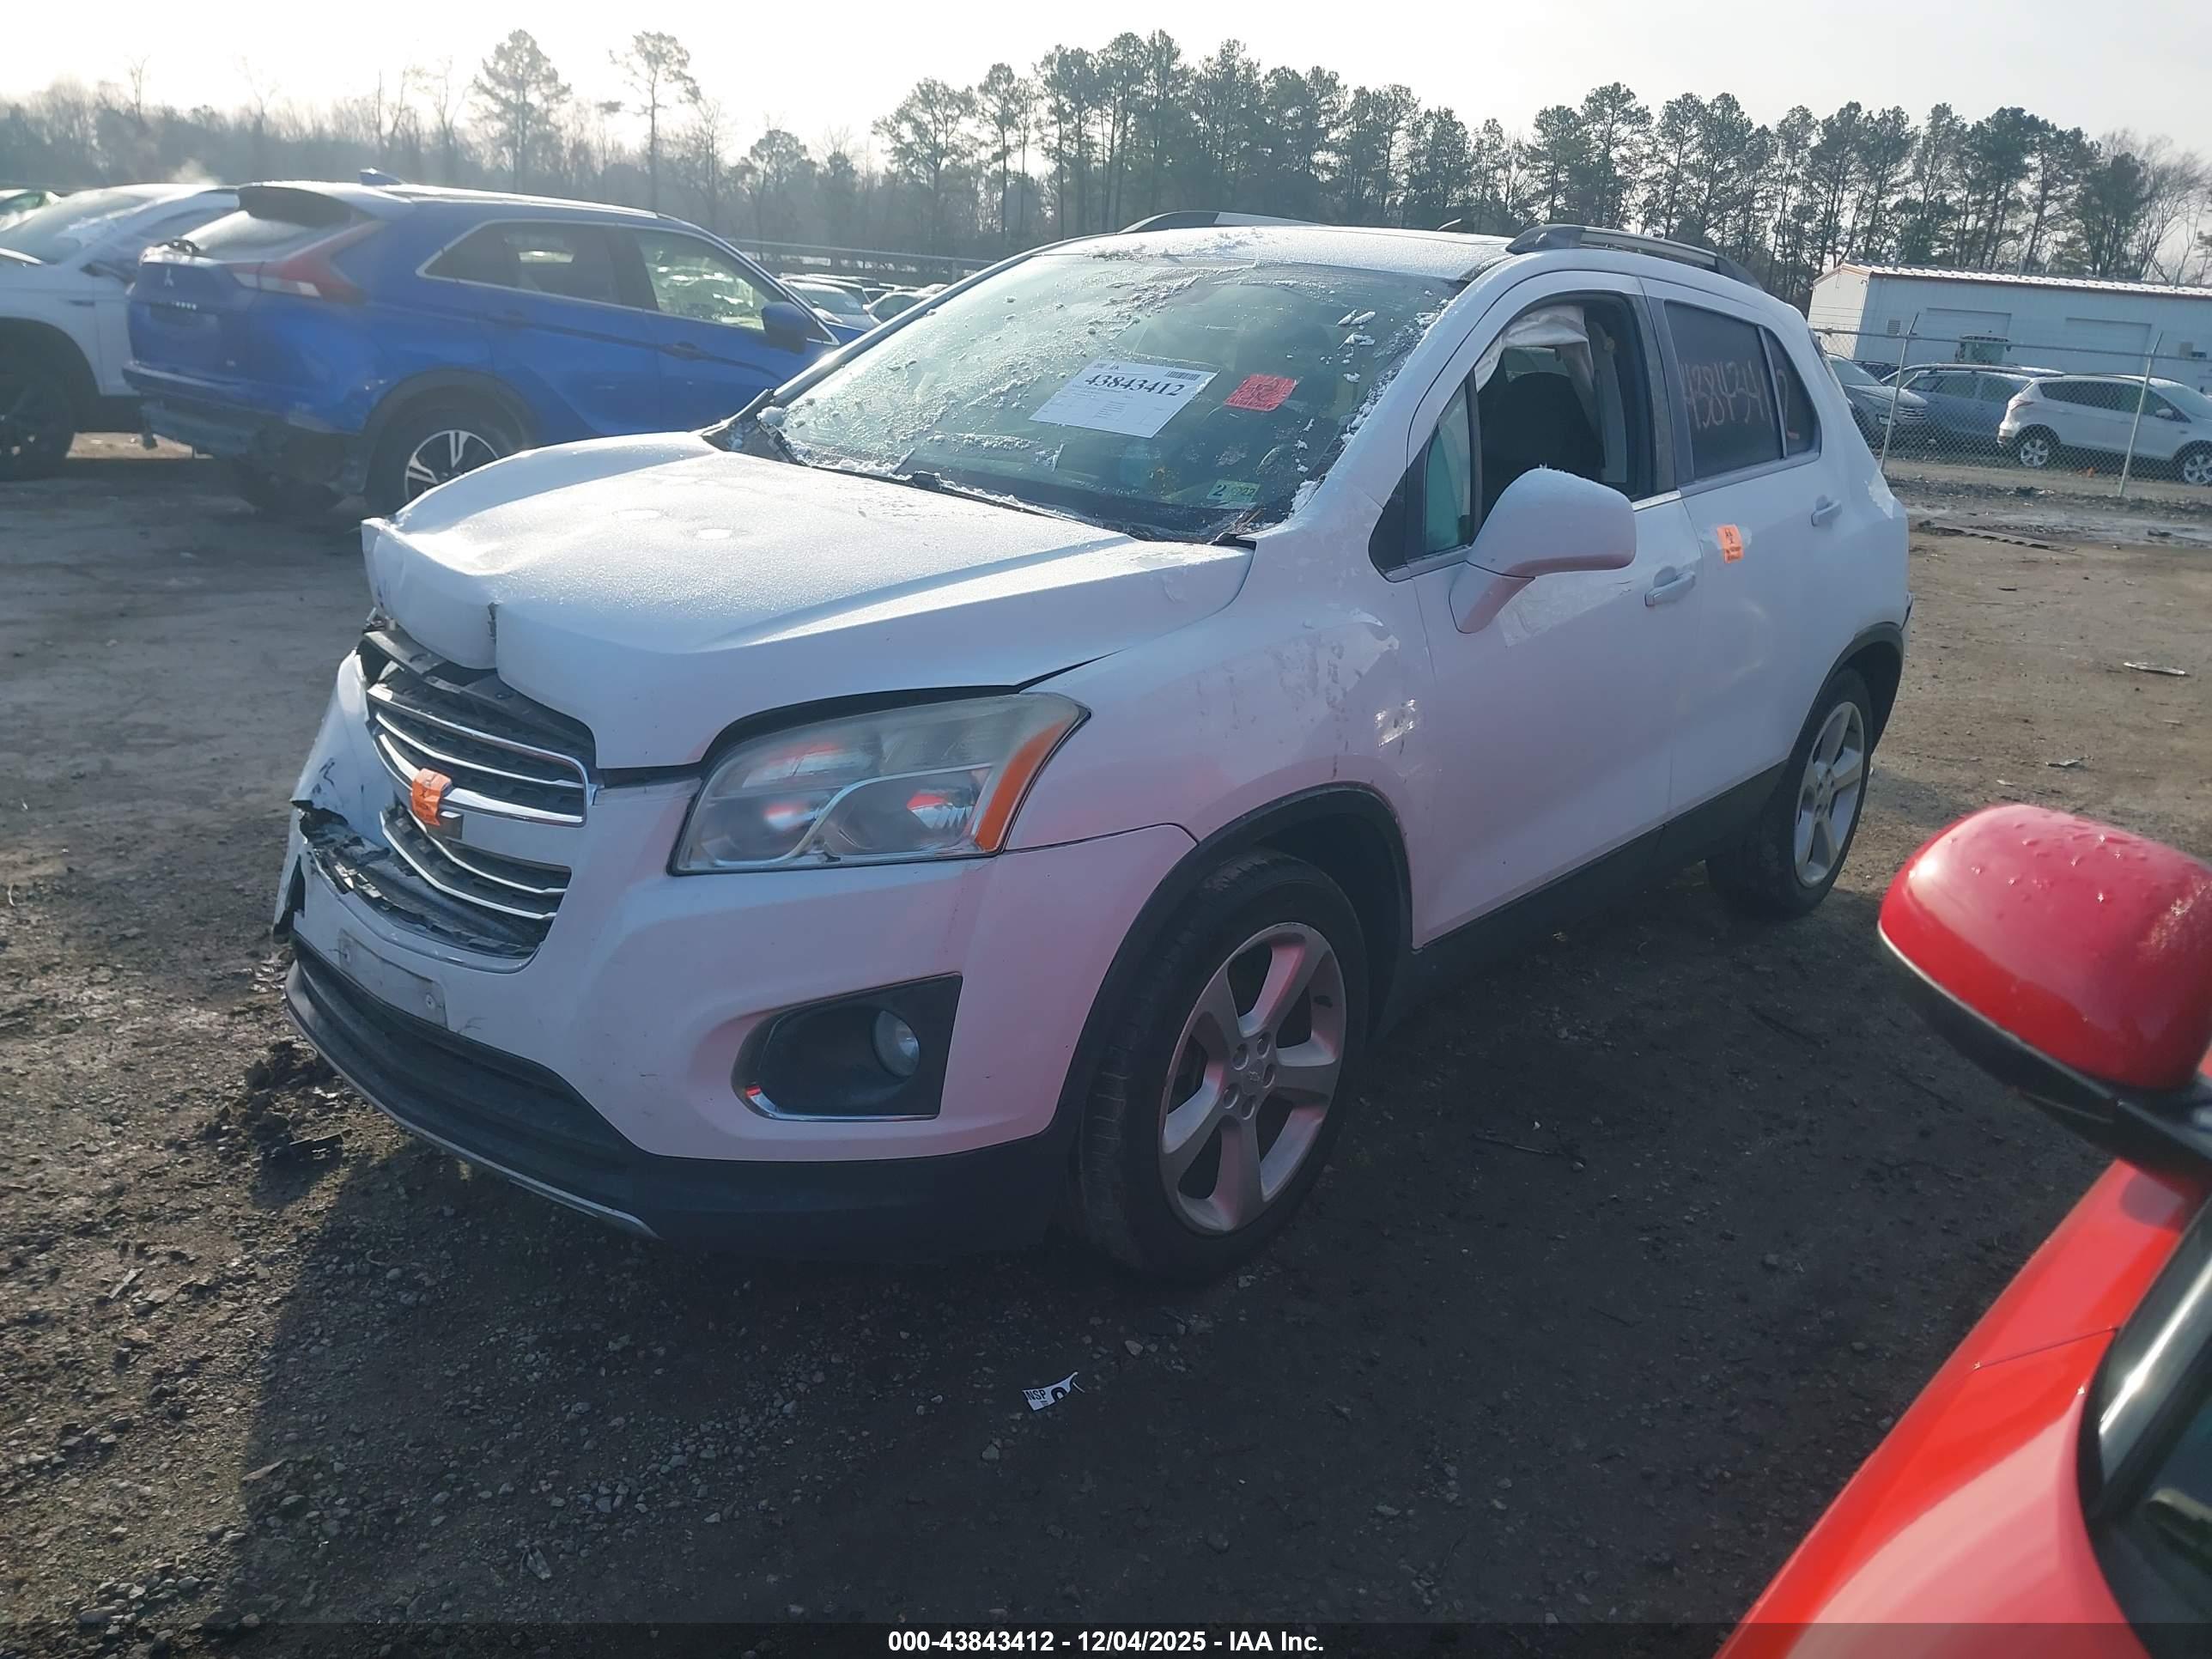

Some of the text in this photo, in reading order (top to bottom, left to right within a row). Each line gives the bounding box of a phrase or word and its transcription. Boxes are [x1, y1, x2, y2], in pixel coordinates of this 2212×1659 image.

[1085, 374, 1185, 397] 43843412
[1212, 483, 1227, 496] 2
[1025, 1389, 1046, 1401] NSP
